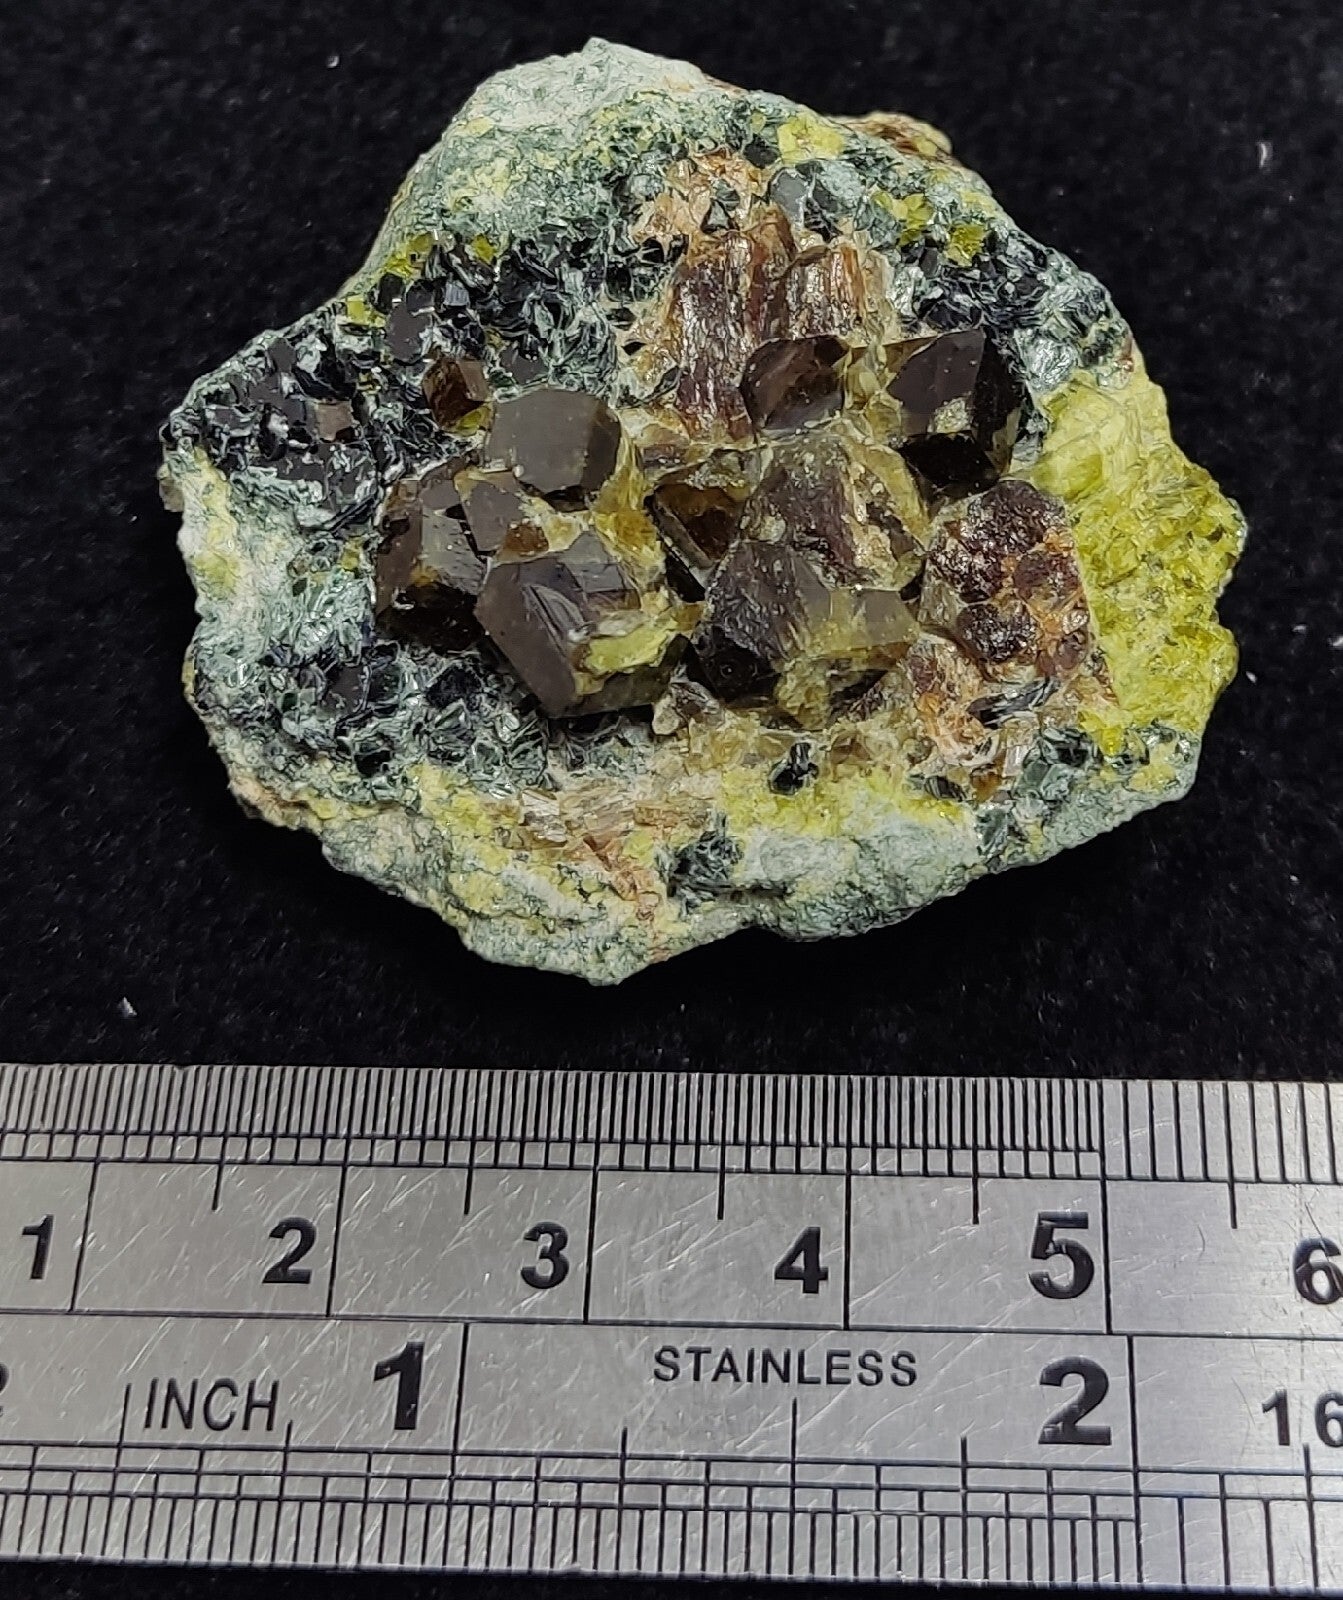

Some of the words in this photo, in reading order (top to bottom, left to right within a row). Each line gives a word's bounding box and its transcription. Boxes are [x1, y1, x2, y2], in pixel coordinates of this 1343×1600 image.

[21, 1214, 54, 1279] 1
[262, 1217, 317, 1284] 2
[520, 1221, 570, 1289] 3
[774, 1226, 829, 1294] 4
[1028, 1211, 1095, 1299] 5
[1293, 1237, 1343, 1305] 6
[374, 1341, 426, 1431] 1
[653, 1345, 918, 1387] STAINLESS
[143, 1379, 280, 1432] INCH
[1039, 1355, 1112, 1446] 2
